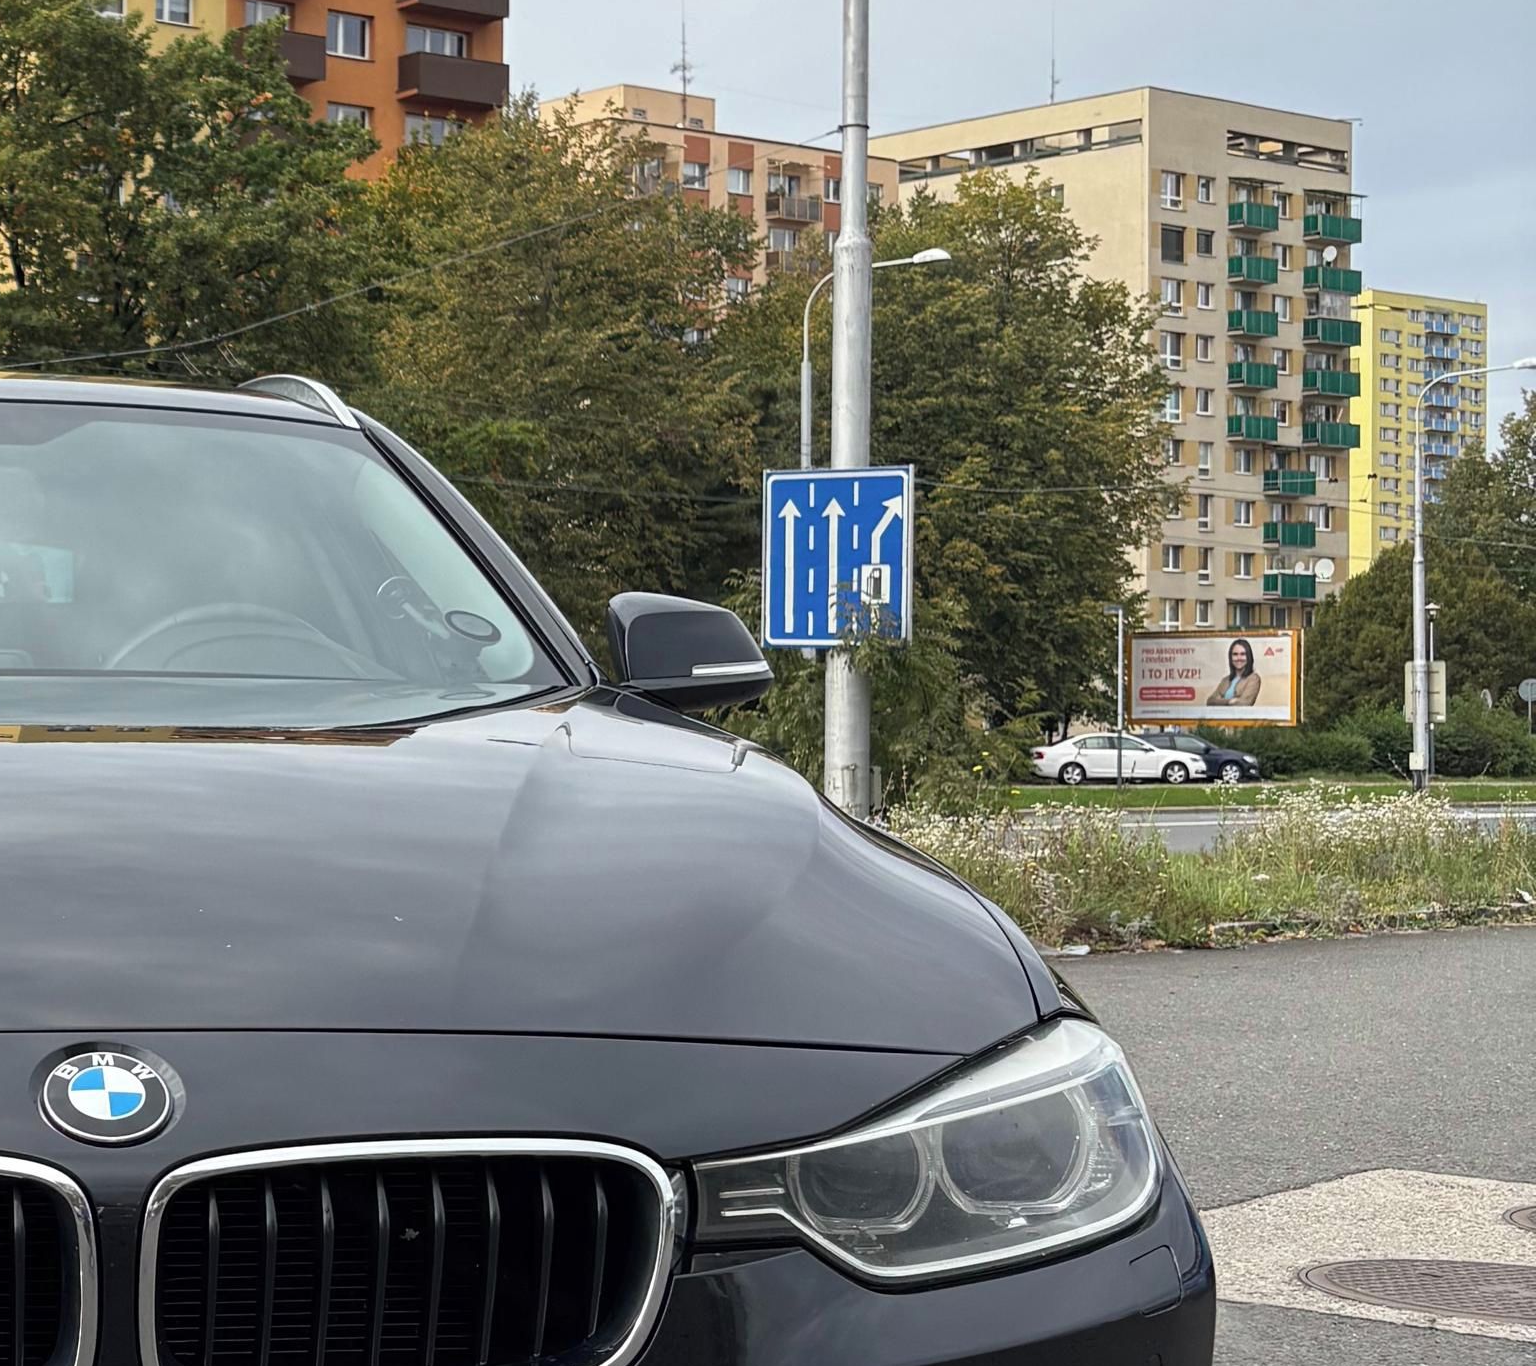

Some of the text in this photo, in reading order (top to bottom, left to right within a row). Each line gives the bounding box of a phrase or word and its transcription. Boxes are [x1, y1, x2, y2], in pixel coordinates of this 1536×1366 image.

[1148, 668, 1162, 679] TO
[1165, 668, 1175, 681] JE
[1177, 668, 1201, 679] VZP!
[54, 1053, 156, 1081] BMW
